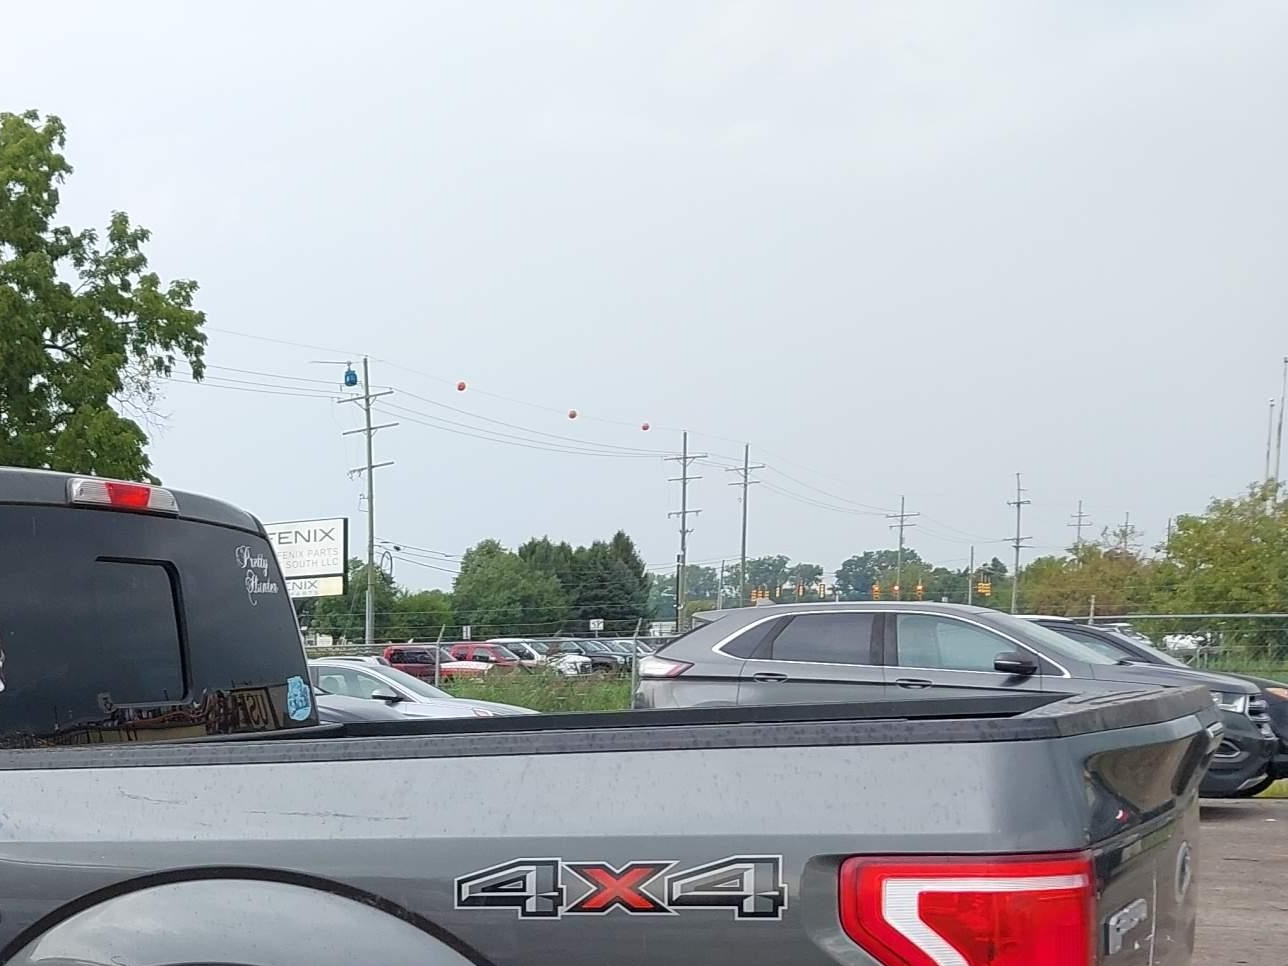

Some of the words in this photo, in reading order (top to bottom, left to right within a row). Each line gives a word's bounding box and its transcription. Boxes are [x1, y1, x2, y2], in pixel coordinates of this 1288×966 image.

[307, 547, 338, 557] PARTS
[286, 559, 318, 569] SOUTH
[321, 557, 338, 567] LLC
